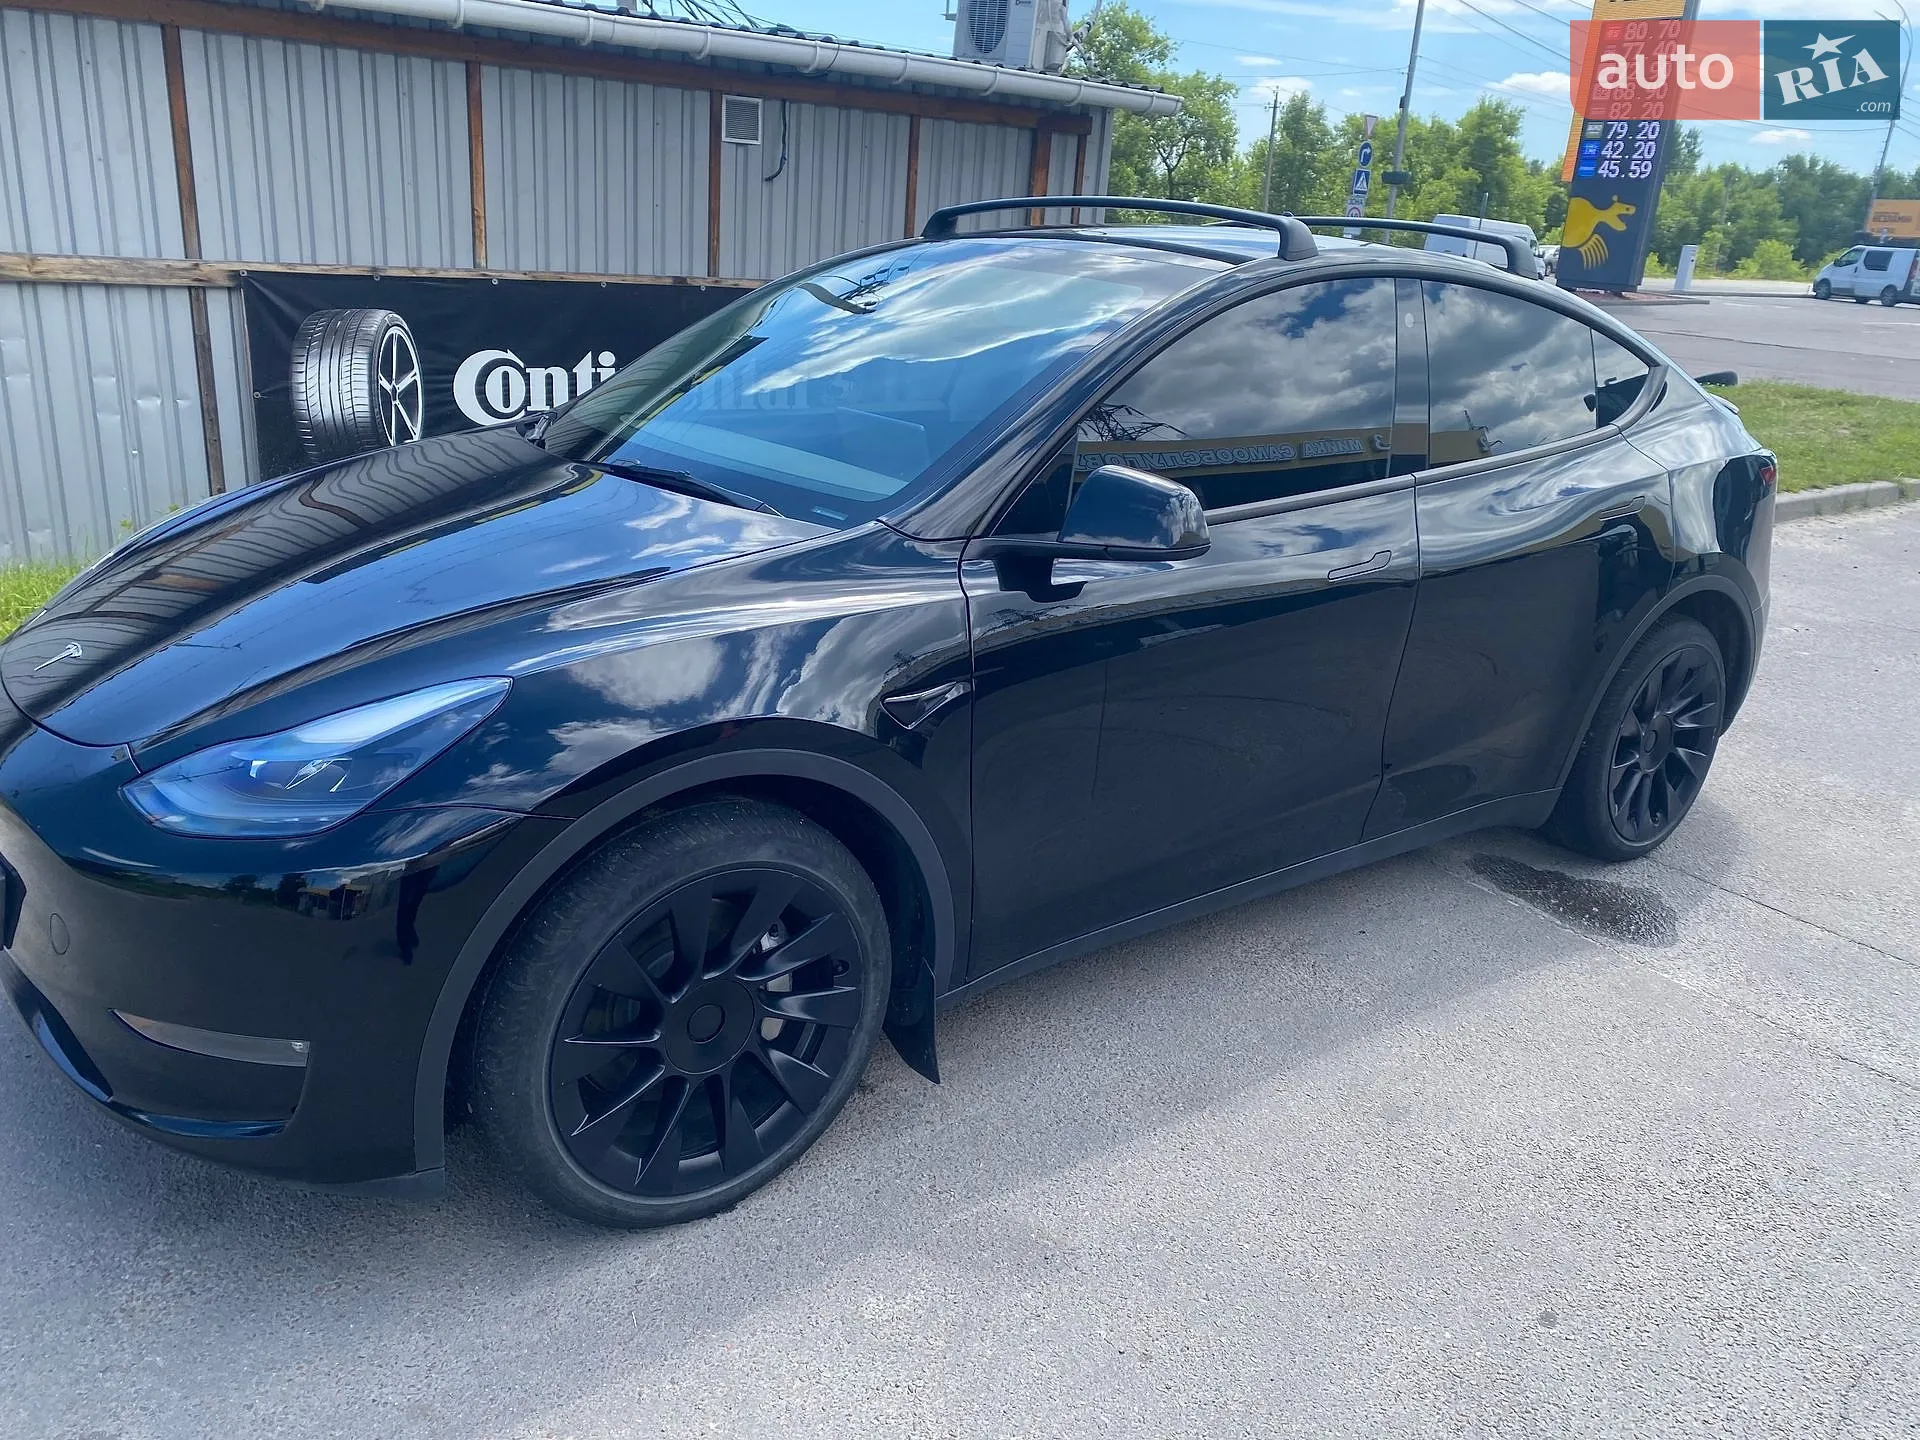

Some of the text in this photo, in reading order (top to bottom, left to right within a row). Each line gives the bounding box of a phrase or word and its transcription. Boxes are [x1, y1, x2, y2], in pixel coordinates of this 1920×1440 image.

[1606, 121, 1660, 139] 79.20
[1601, 140, 1656, 159] 42.20
[1598, 160, 1652, 179] 45.59
